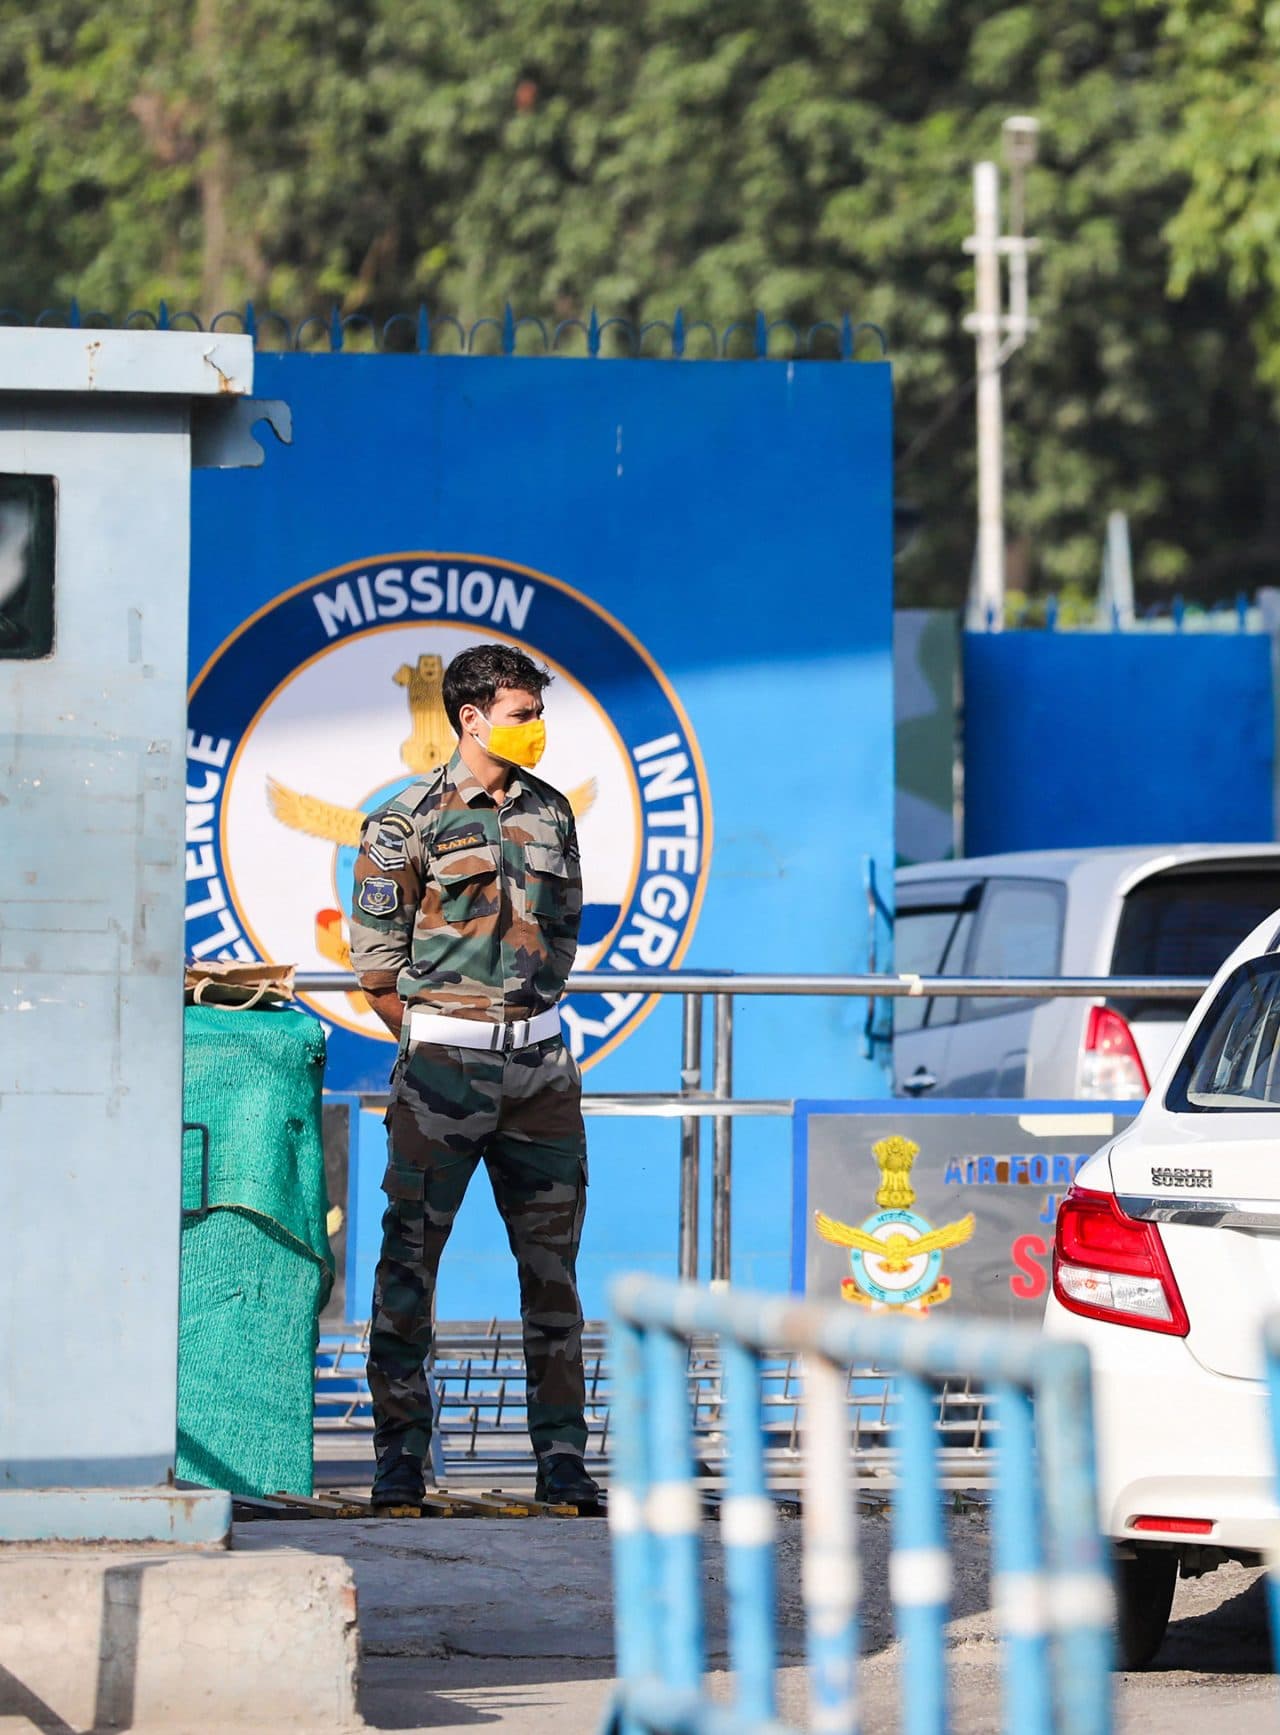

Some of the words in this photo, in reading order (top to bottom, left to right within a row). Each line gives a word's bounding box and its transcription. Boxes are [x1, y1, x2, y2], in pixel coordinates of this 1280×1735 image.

[312, 566, 535, 638] MISSION
[944, 1155, 996, 1185] AIR
[1151, 1167, 1212, 1178] MARUTI
[1151, 1176, 1212, 1188] SUZUKI
